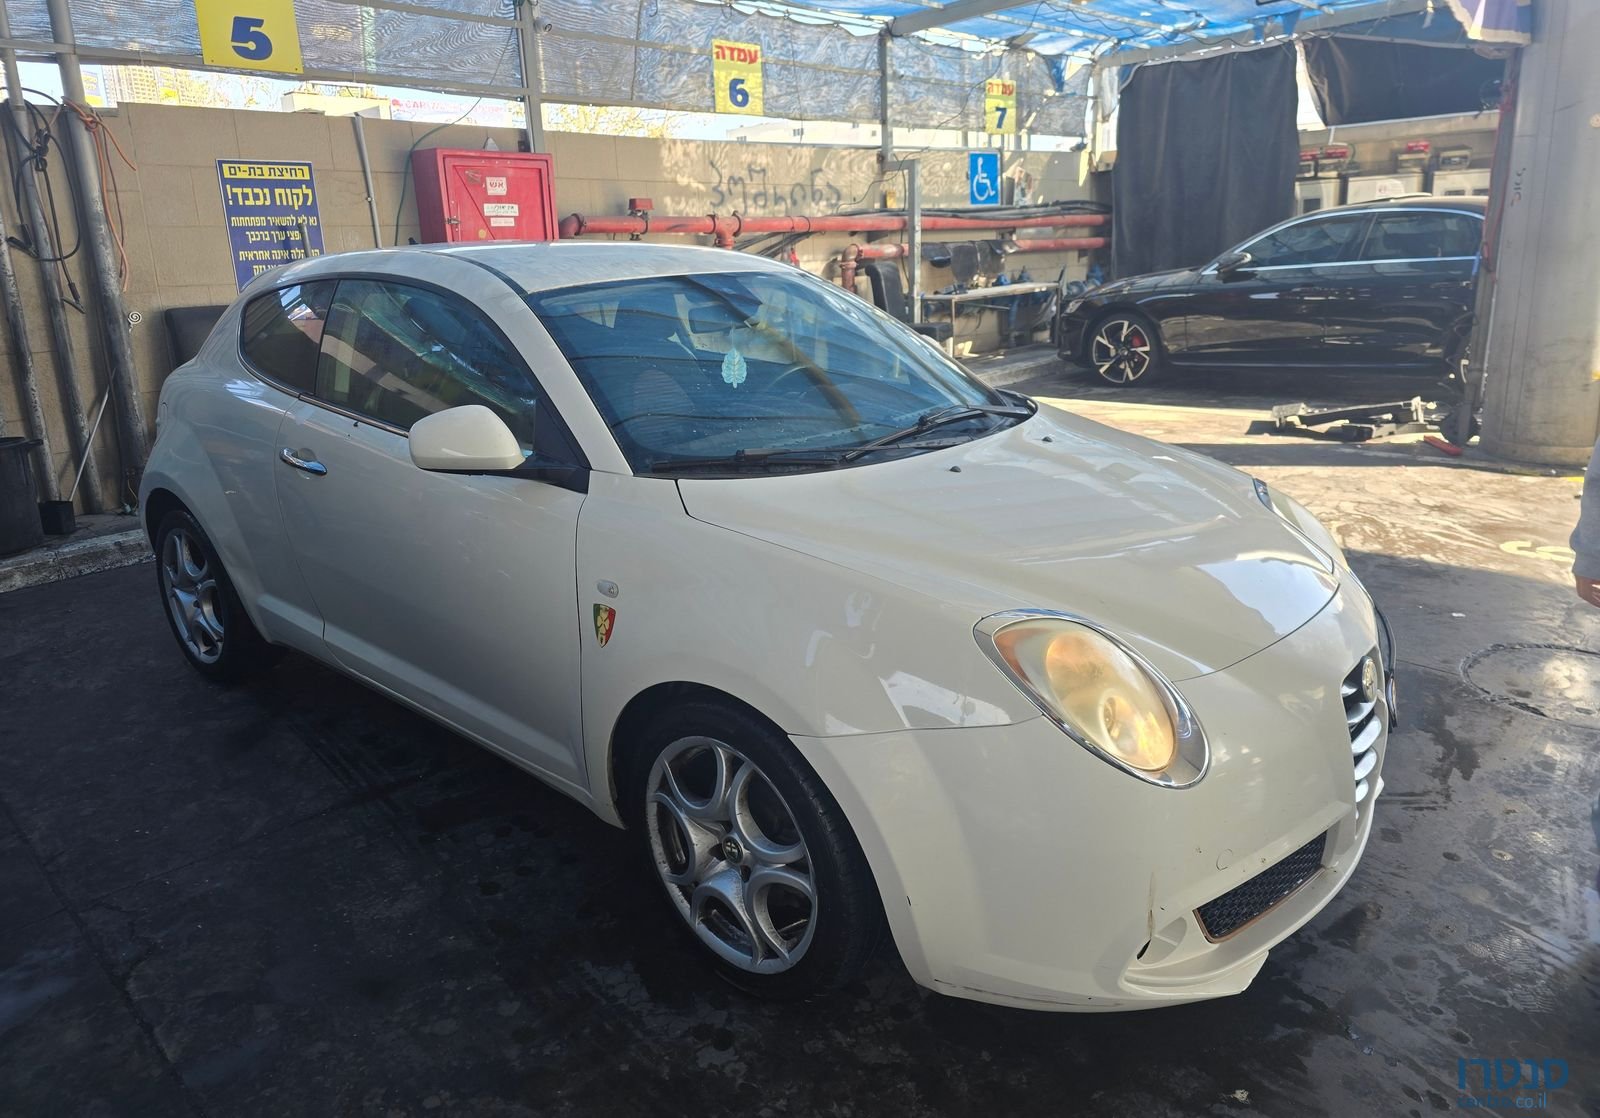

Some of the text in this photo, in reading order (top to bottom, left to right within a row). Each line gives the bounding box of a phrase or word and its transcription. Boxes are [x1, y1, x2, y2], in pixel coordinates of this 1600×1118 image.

[231, 16, 273, 60] 5
[714, 45, 759, 64] עמדה
[729, 78, 749, 107] 6
[987, 82, 1014, 96] עמדה
[995, 107, 1007, 129] 7
[228, 166, 305, 178] רחיצת בת-ים
[226, 184, 313, 210] לקוח נכבד!
[268, 214, 296, 226] להשאיר
[308, 216, 317, 226] נא
[245, 230, 302, 244] פצי ערך ברכבך
[239, 249, 271, 261] אחראית
[271, 249, 289, 260] אינה
